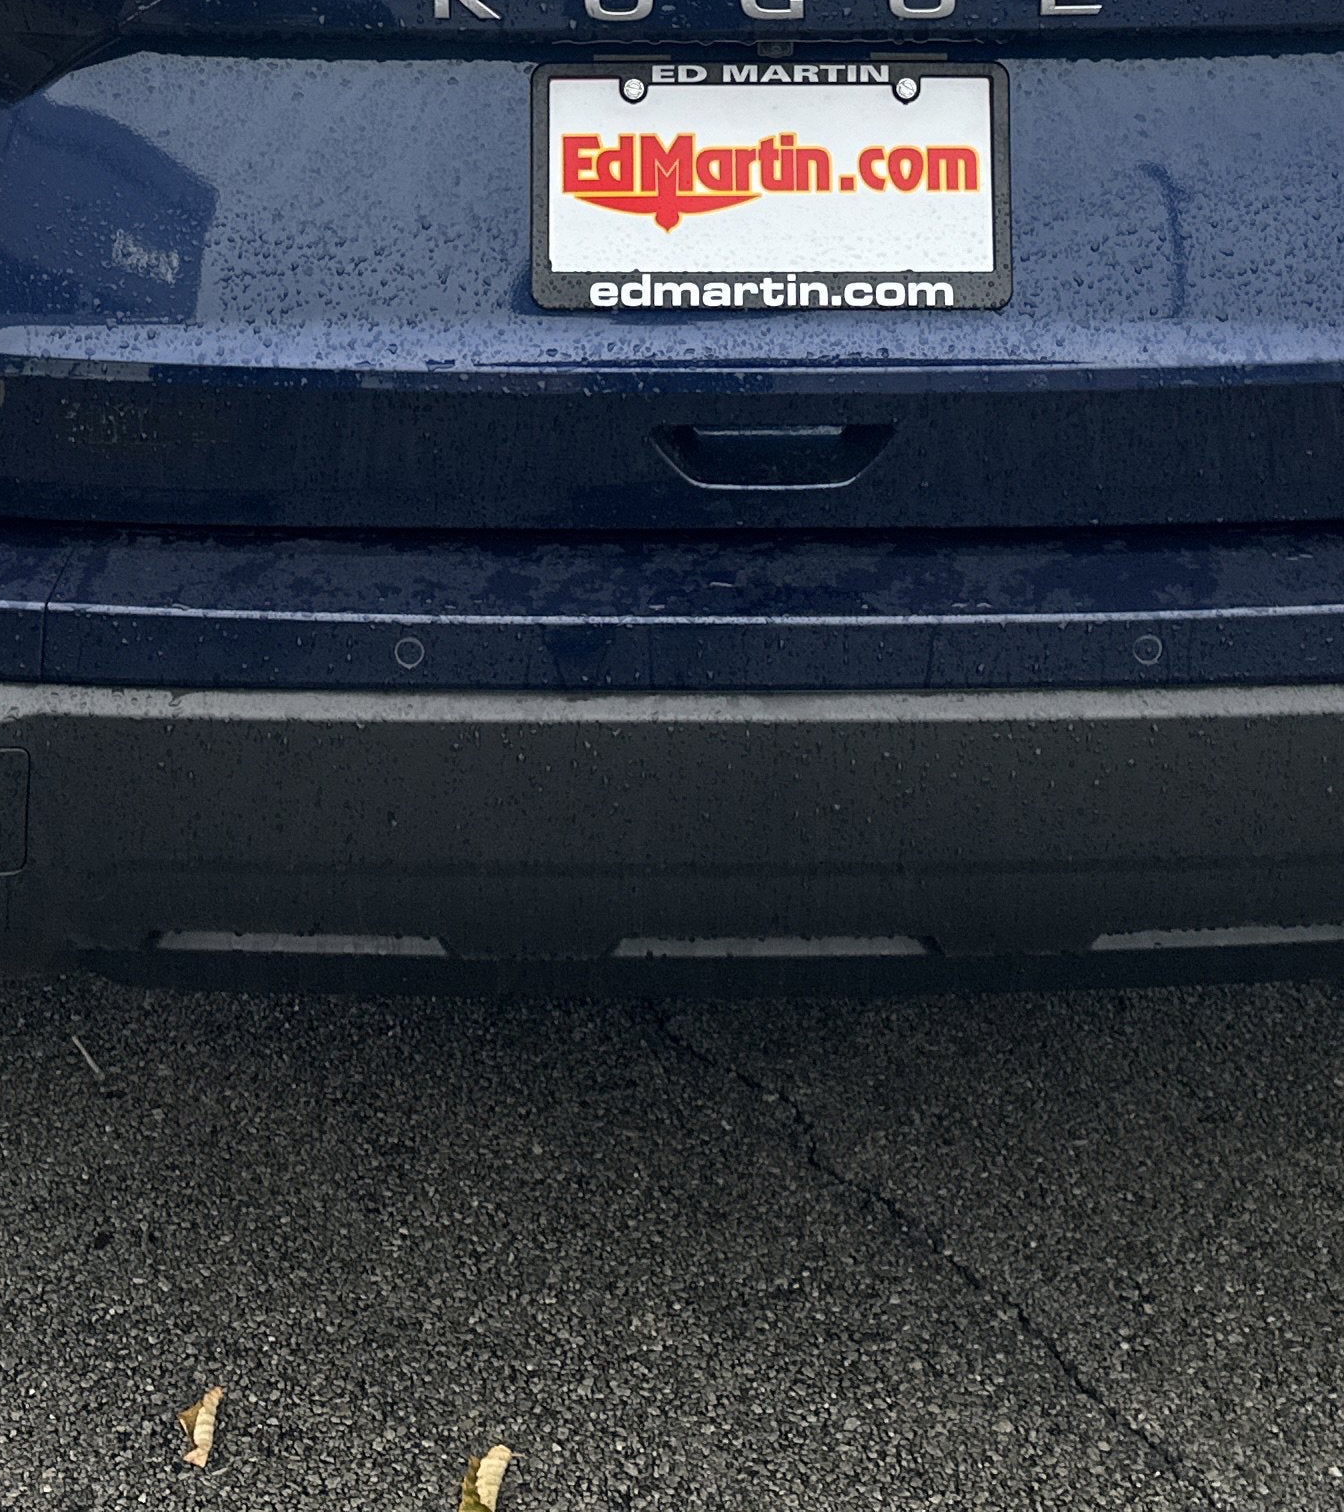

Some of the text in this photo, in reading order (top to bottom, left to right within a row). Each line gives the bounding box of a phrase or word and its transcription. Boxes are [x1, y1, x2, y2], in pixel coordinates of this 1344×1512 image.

[651, 64, 889, 83] ED MARTIN
[561, 132, 981, 193] EdMartin.com
[589, 273, 954, 307] edmartin.com
